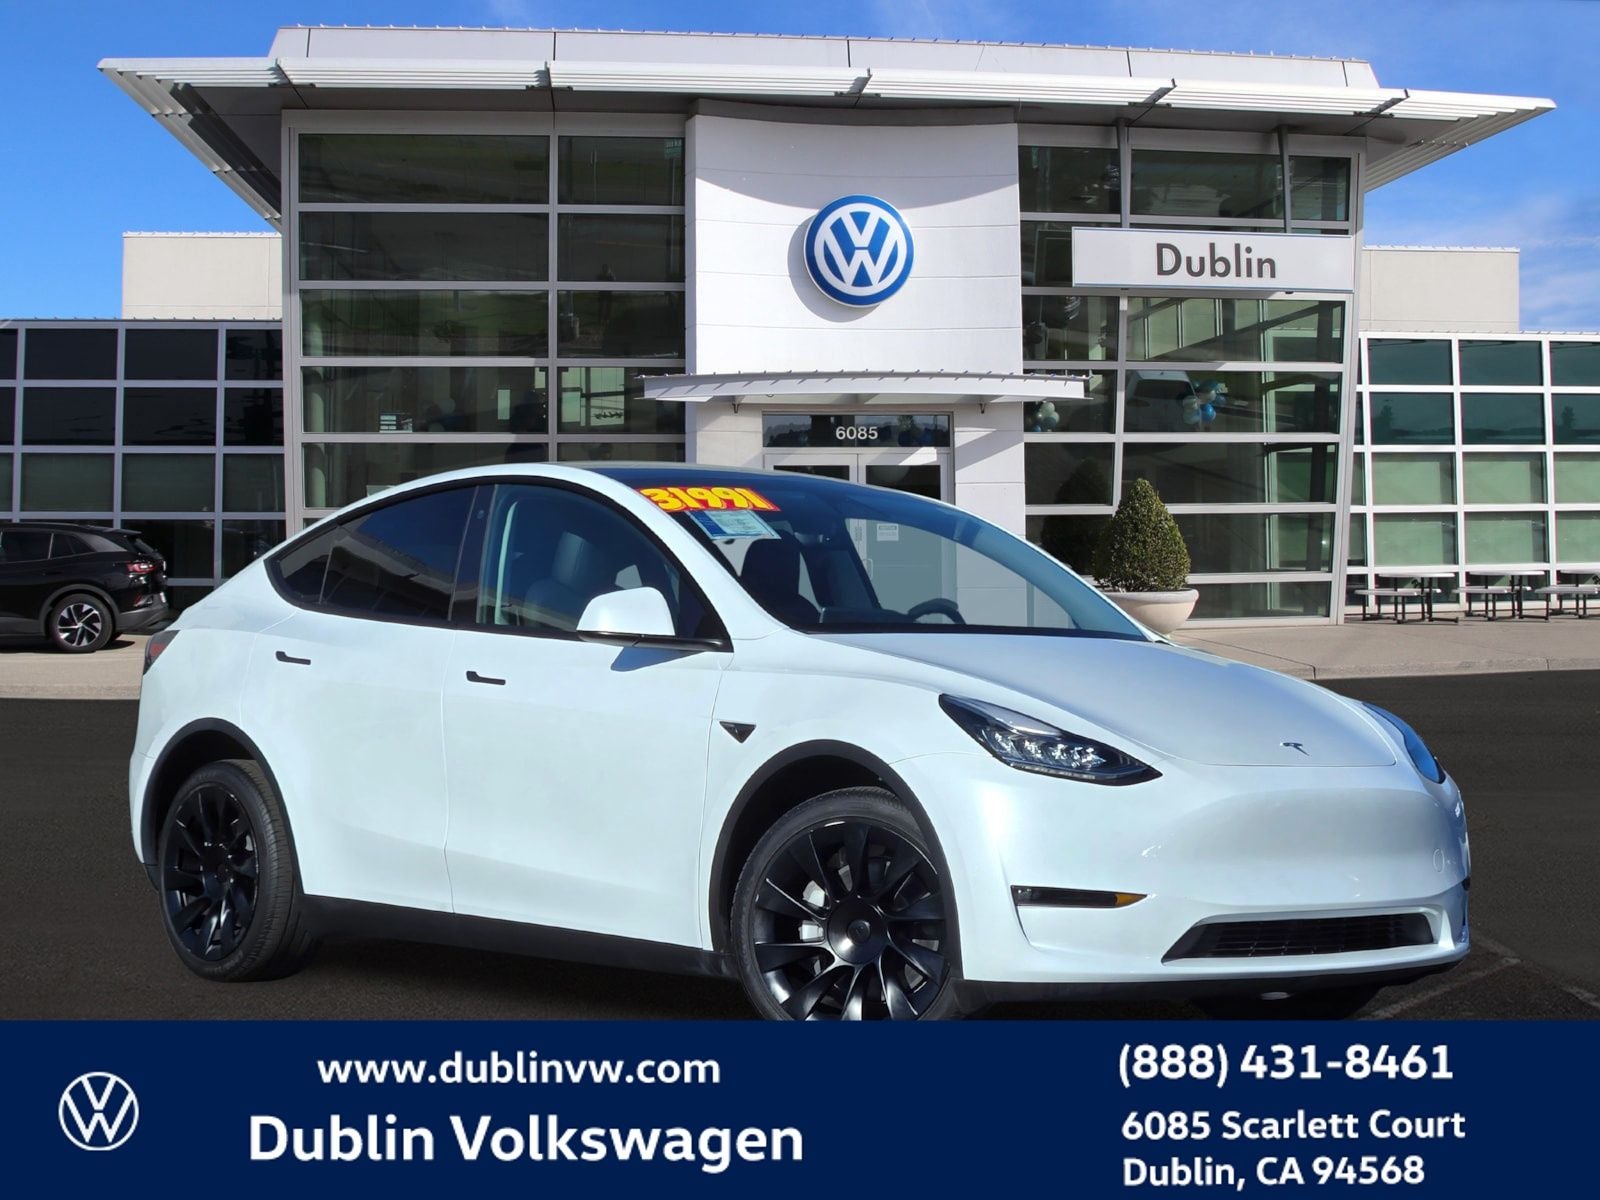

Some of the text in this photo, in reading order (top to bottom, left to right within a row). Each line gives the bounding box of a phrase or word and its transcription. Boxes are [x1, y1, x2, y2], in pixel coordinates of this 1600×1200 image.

[813, 202, 907, 297] VW
[1156, 242, 1276, 279] Dublin
[835, 426, 878, 440] 6085
[640, 487, 772, 511] 31991
